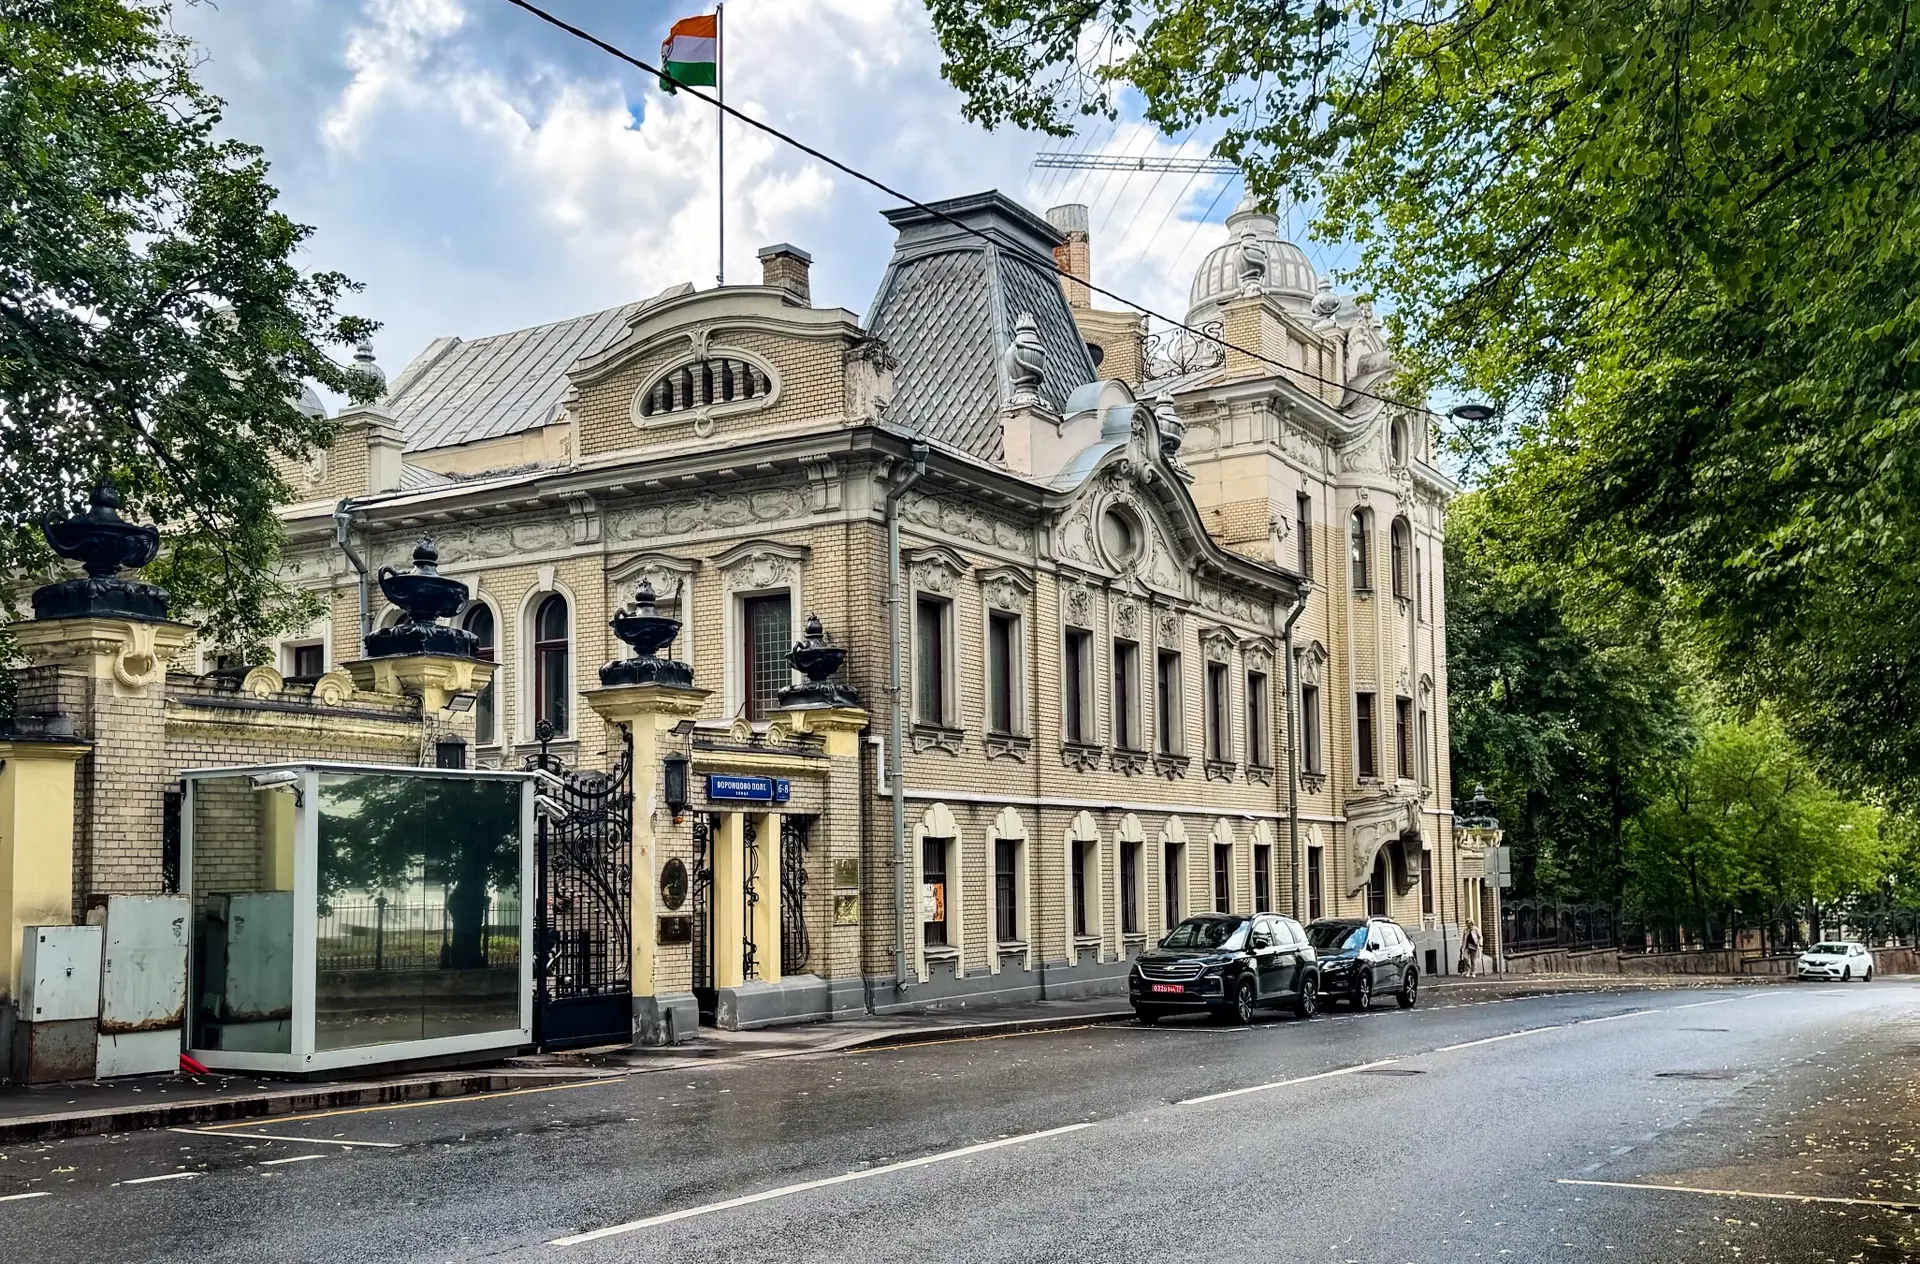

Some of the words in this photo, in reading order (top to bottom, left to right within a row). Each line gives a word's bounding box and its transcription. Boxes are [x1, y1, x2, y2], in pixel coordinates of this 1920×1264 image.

[717, 781, 751, 790] ВОРОНЦОВО
[751, 782, 767, 791] ПОЛЕ
[778, 784, 789, 794] 6-8
